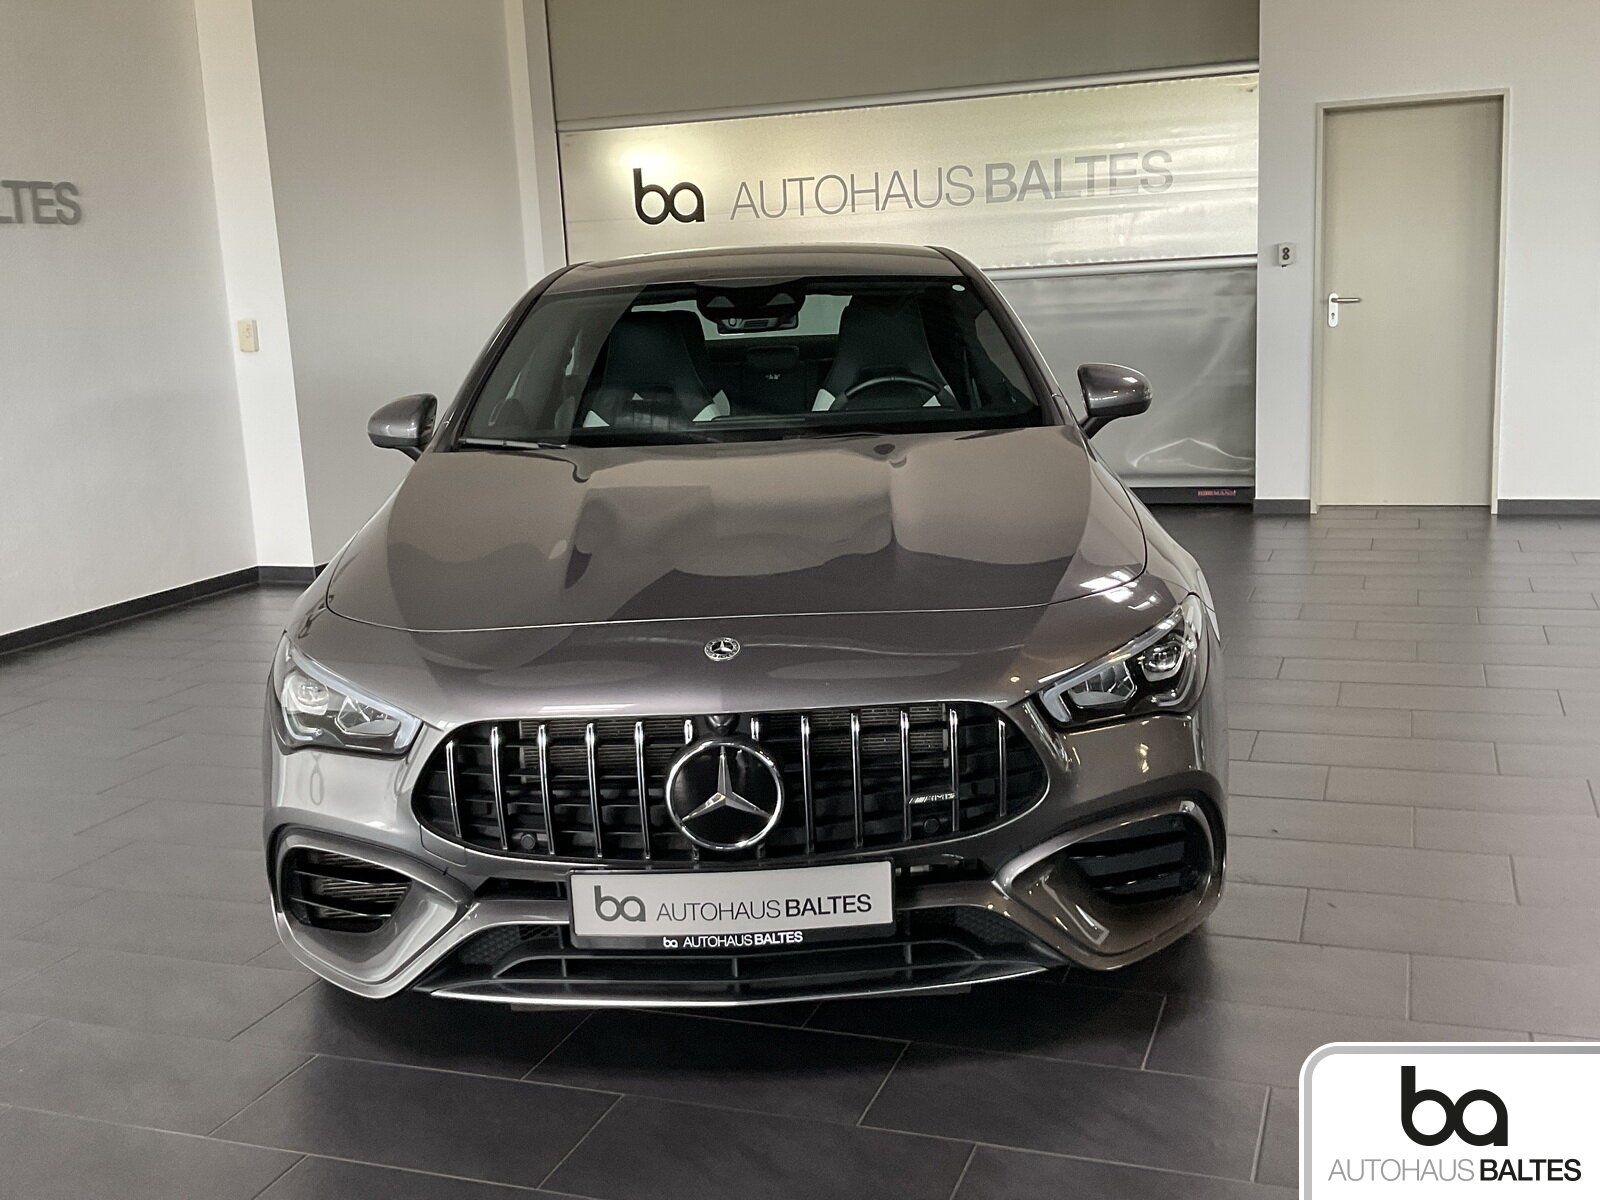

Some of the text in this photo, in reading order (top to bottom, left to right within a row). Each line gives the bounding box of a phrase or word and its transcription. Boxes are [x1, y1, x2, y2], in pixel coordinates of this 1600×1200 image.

[632, 149, 1174, 225] ba AUTOHAUS BALTES
[594, 885, 872, 922] ba AUTOHAUS BALTES
[663, 931, 804, 948] ba AUTOHAUS BALTES
